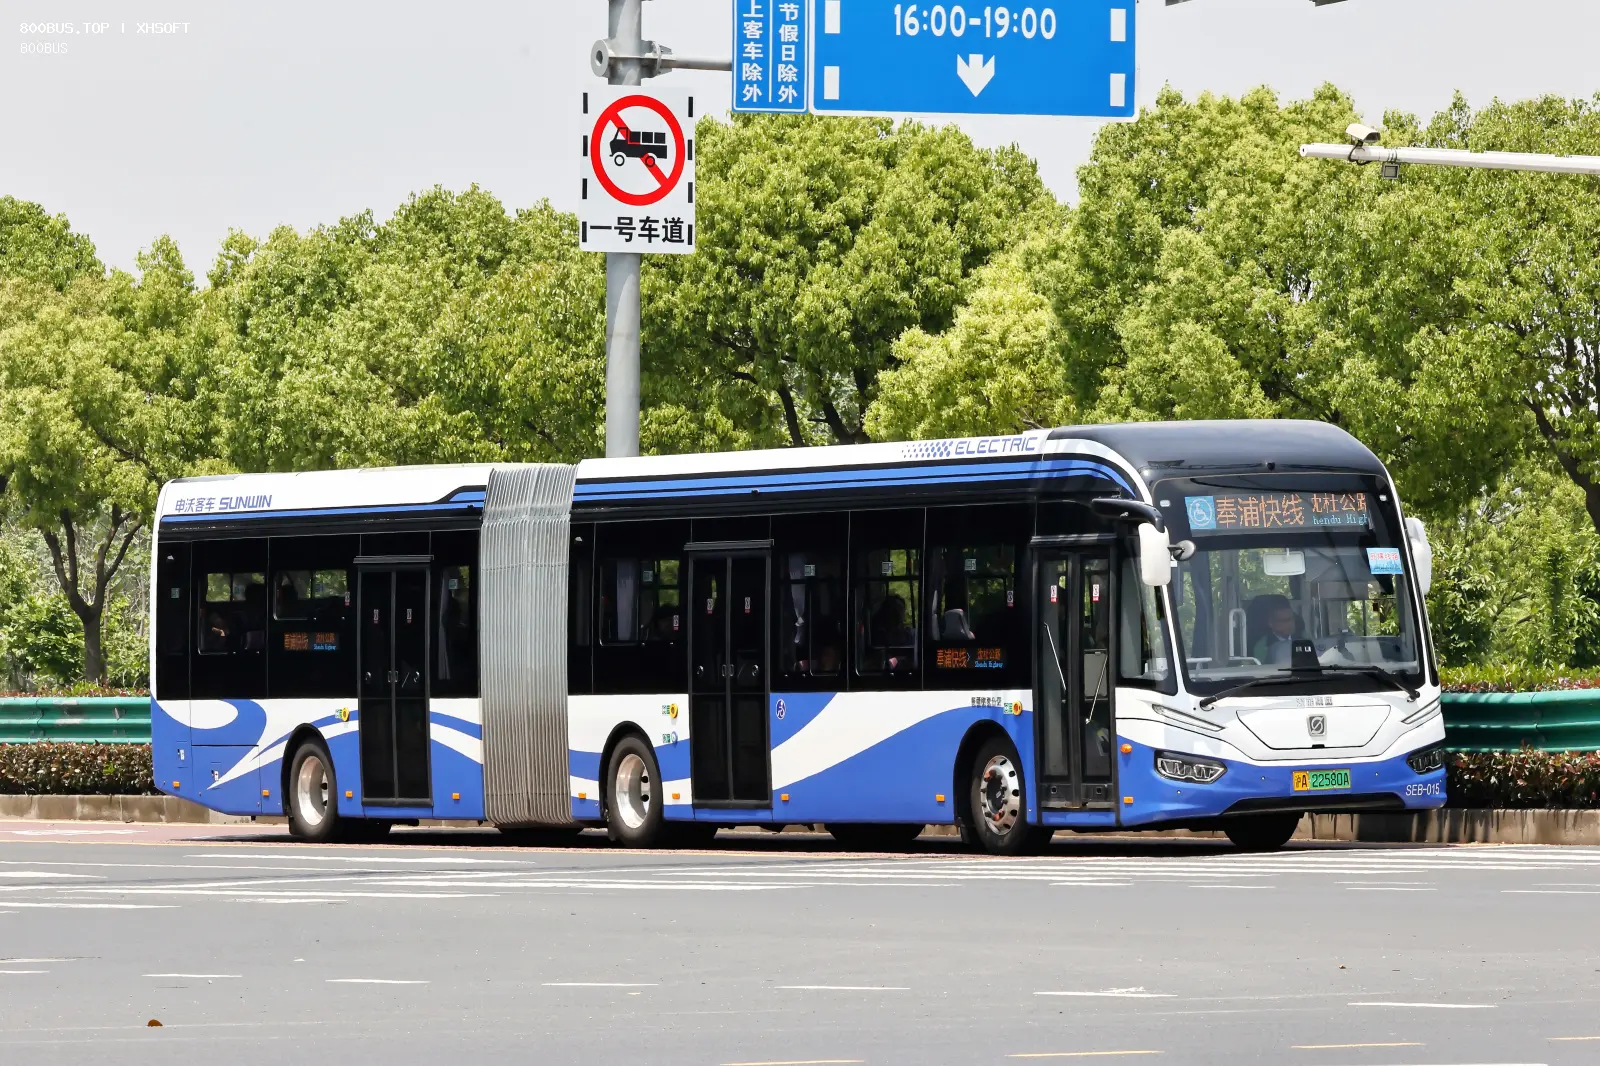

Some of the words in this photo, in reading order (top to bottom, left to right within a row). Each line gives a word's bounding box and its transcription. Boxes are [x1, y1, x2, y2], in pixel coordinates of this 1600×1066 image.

[894, 4, 1057, 40] 16:00-19:00
[777, 3, 800, 104] 节假日除外
[589, 215, 685, 244] 一号车道
[954, 436, 1038, 456] ELECTRIC
[175, 497, 216, 513] 申沃客车
[218, 494, 272, 511] SUNWIN
[1216, 494, 1305, 529] 奉浦快线
[1405, 782, 1441, 797] SEB-015
